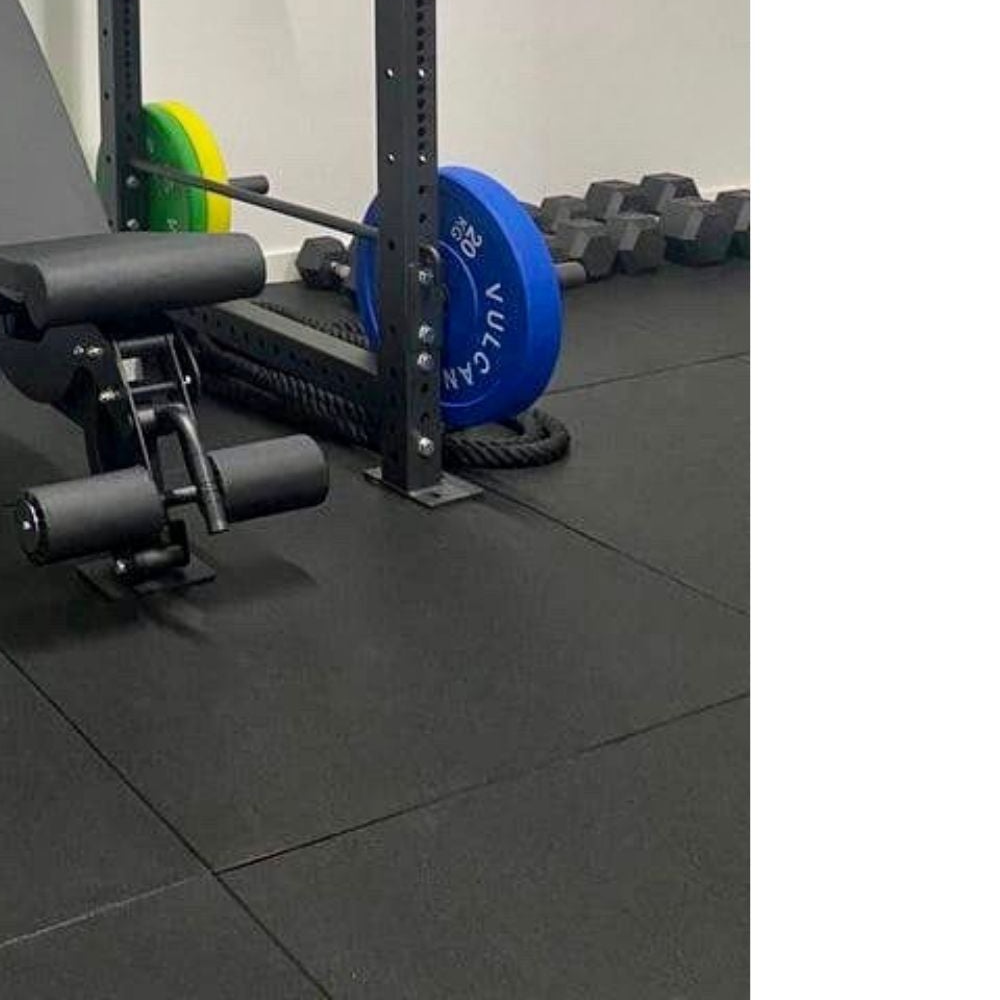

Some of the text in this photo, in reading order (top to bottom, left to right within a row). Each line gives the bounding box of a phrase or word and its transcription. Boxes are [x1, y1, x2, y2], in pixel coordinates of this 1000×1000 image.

[450, 215, 469, 242] KG
[460, 225, 484, 259] 20
[443, 282, 505, 391] VULCAN
